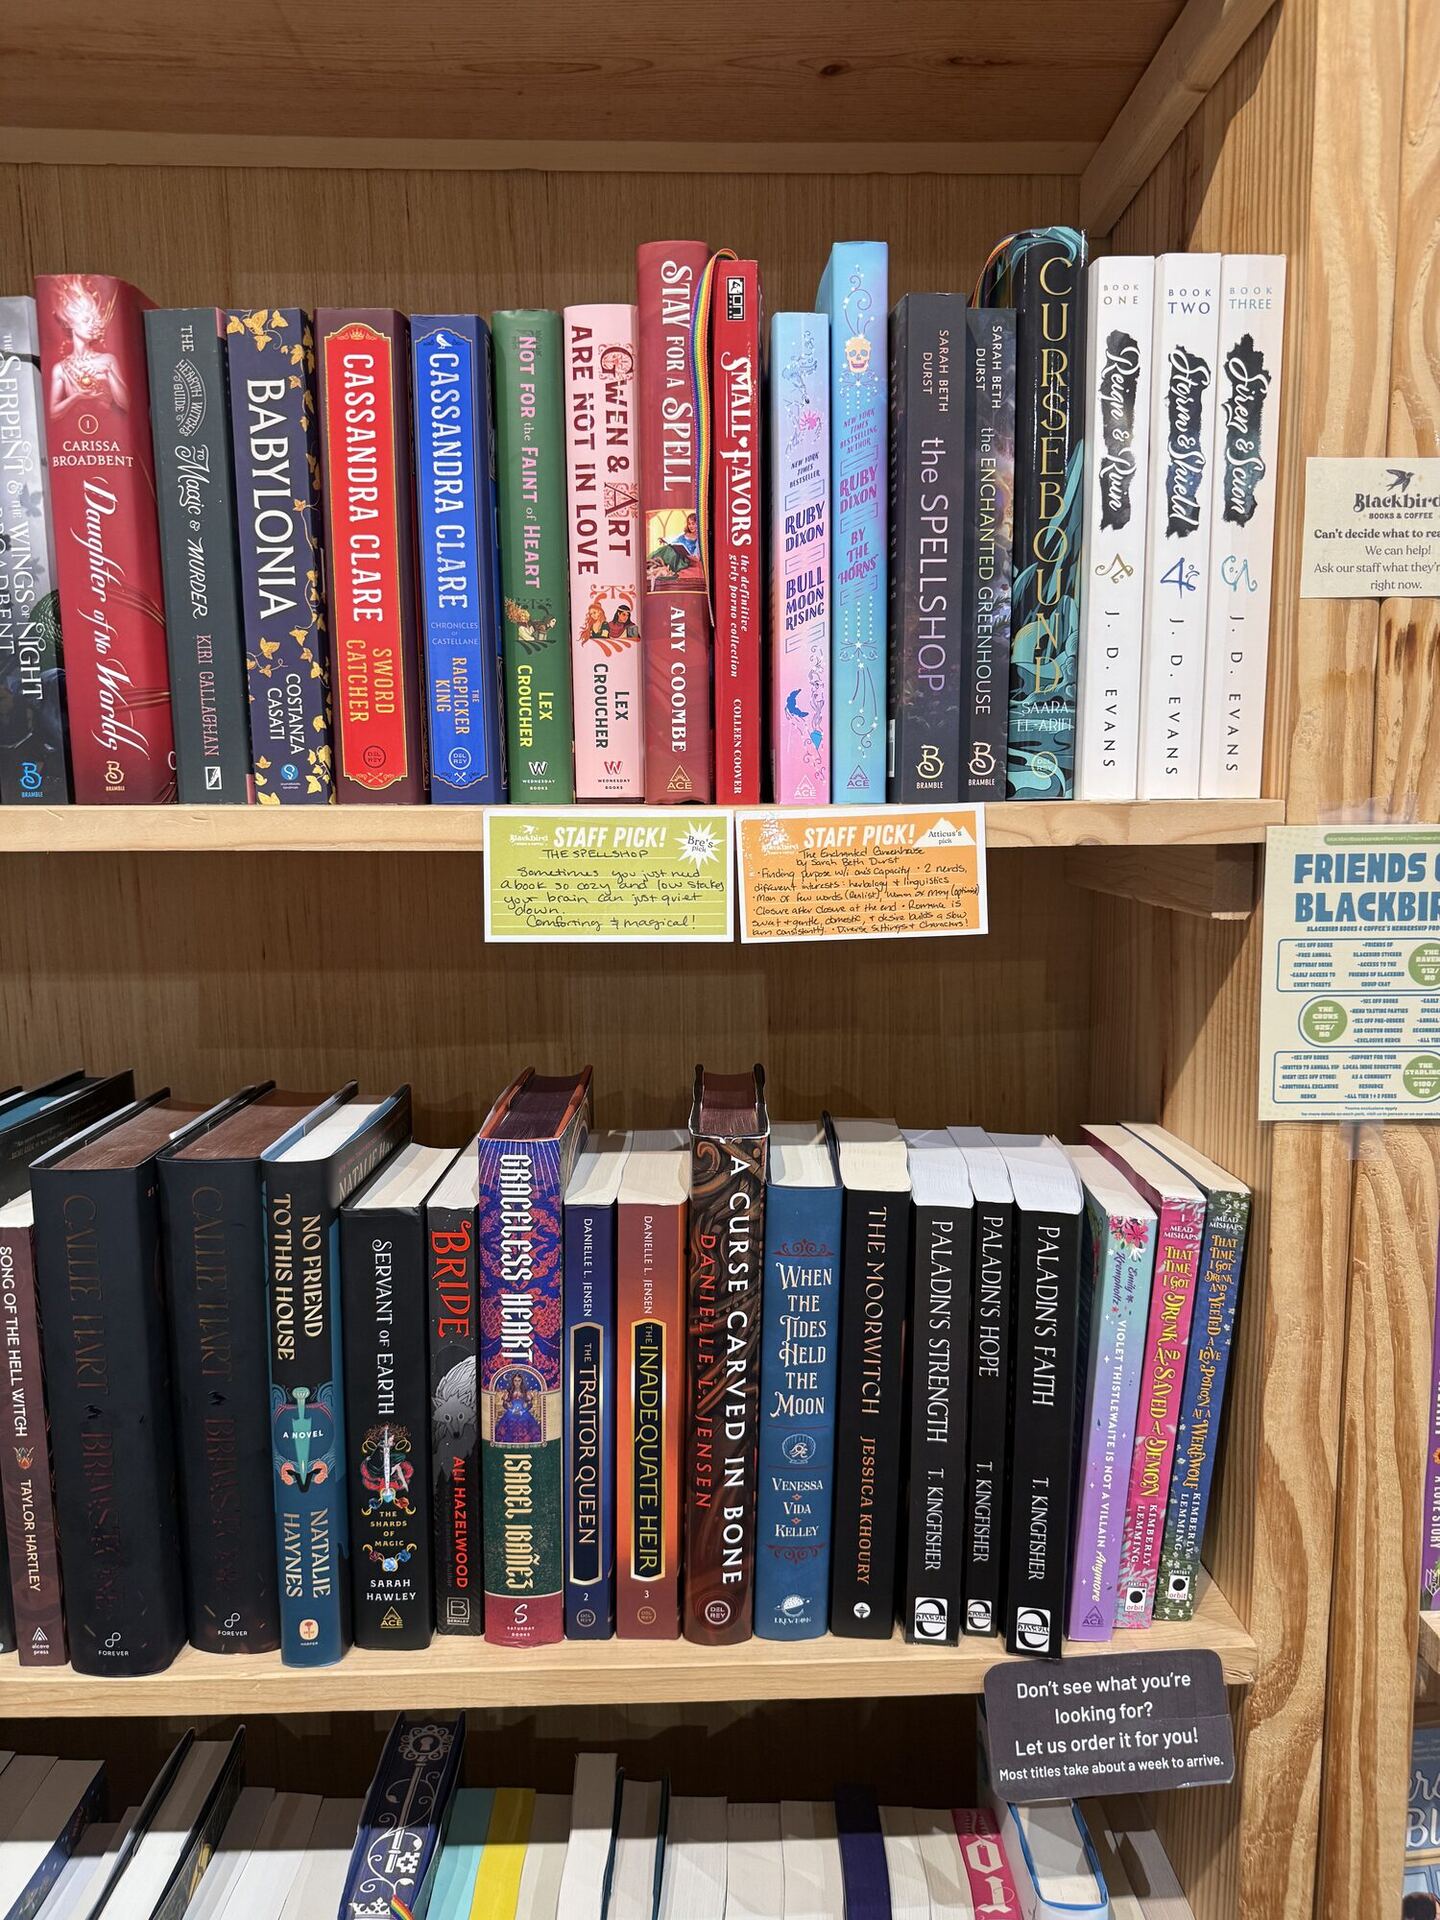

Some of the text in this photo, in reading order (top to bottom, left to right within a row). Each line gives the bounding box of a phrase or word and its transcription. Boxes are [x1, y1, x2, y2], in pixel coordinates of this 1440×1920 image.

[1168, 289, 1211, 297] BOOK
[1168, 302, 1210, 315] TWO
[661, 260, 693, 492] STAY FOR A SPELL
[53, 441, 134, 468] CARISSA BROADBENT
[519, 336, 540, 588] NOT FOR the FAINT of HEART
[571, 325, 599, 575] ARE NOT IN LOVE
[606, 455, 630, 473] &
[719, 351, 752, 546] SMALL FAVORS
[1033, 257, 1072, 693] CURSEBOUND
[247, 378, 297, 620] BABYLONIA
[343, 354, 382, 622] CASSANDRA CLARE
[785, 501, 825, 535] RUBY
[785, 522, 824, 552] DIXON
[918, 438, 949, 691] the SPELLSHOP
[1314, 528, 1423, 539] Can't decide what to
[1314, 563, 1408, 573] Ask our staff what
[786, 567, 825, 599] BULL
[786, 586, 824, 616] MOON
[976, 427, 997, 715] the ENCHANTED GREENHOUSE
[1371, 581, 1396, 591] right
[786, 602, 824, 631] RISING
[196, 635, 219, 756] KIRI CALLAGHAN
[267, 687, 285, 740] CASATI
[286, 673, 305, 755] COSTANZA
[346, 639, 369, 722] CATCHER
[372, 648, 395, 714] SWORD
[435, 679, 451, 713] KING
[452, 657, 470, 735] RAGPICKER
[517, 665, 532, 748] CROUCHER
[539, 692, 554, 720] LEX
[670, 606, 686, 753] AMY COOMBE
[1103, 611, 1120, 767] J. D. EVANS
[733, 699, 742, 794] COLLEEN COOVER
[542, 849, 649, 859] THE SPELLSHOP
[554, 827, 666, 847] STAFF PICK!
[688, 835, 714, 848] Bre's
[928, 829, 963, 839] Atticus's
[1294, 853, 1427, 883] FRIENDS
[517, 867, 599, 877] Sometimes
[611, 870, 636, 883] you
[639, 869, 668, 882] just
[1163, 1232, 1198, 1240] MISHAPS
[273, 1193, 295, 1361] TO THIS HOUSE
[301, 1214, 323, 1338] NO FRIEND
[430, 1219, 472, 1339] BRIDE
[861, 1207, 886, 1414] THE MOORWITCH
[379, 1330, 390, 1347] OF
[500, 1292, 534, 1362] HEART
[927, 1221, 953, 1443] PALADIN'S STRENGTH
[1033, 1226, 1061, 1407] PALADIN'S FAITH
[377, 1353, 395, 1415] EARTH
[722, 1156, 750, 1585] A CURSE CARVED IN BONE
[574, 1343, 597, 1544] THE TRAITOR QUEEN
[636, 1324, 659, 1572] THE INADEQUATE HEIR
[20, 1479, 41, 1592] TAYLOR HARTLEY
[452, 1455, 469, 1588] ALI HAZELWOOD
[856, 1436, 875, 1585] JESSICA KHOURY
[1131, 1505, 1146, 1563] LEMMING
[1143, 1504, 1158, 1567] KIMBERLY
[283, 1512, 303, 1597] HAYNES
[310, 1507, 331, 1598] NATALIE
[1017, 1671, 1192, 1699] Don't see what you're
[1055, 1701, 1154, 1724] looking for?
[999, 1754, 1224, 1782] Most titles take about a week to arrive.
[1015, 1726, 1199, 1756] Let us order it for you!
